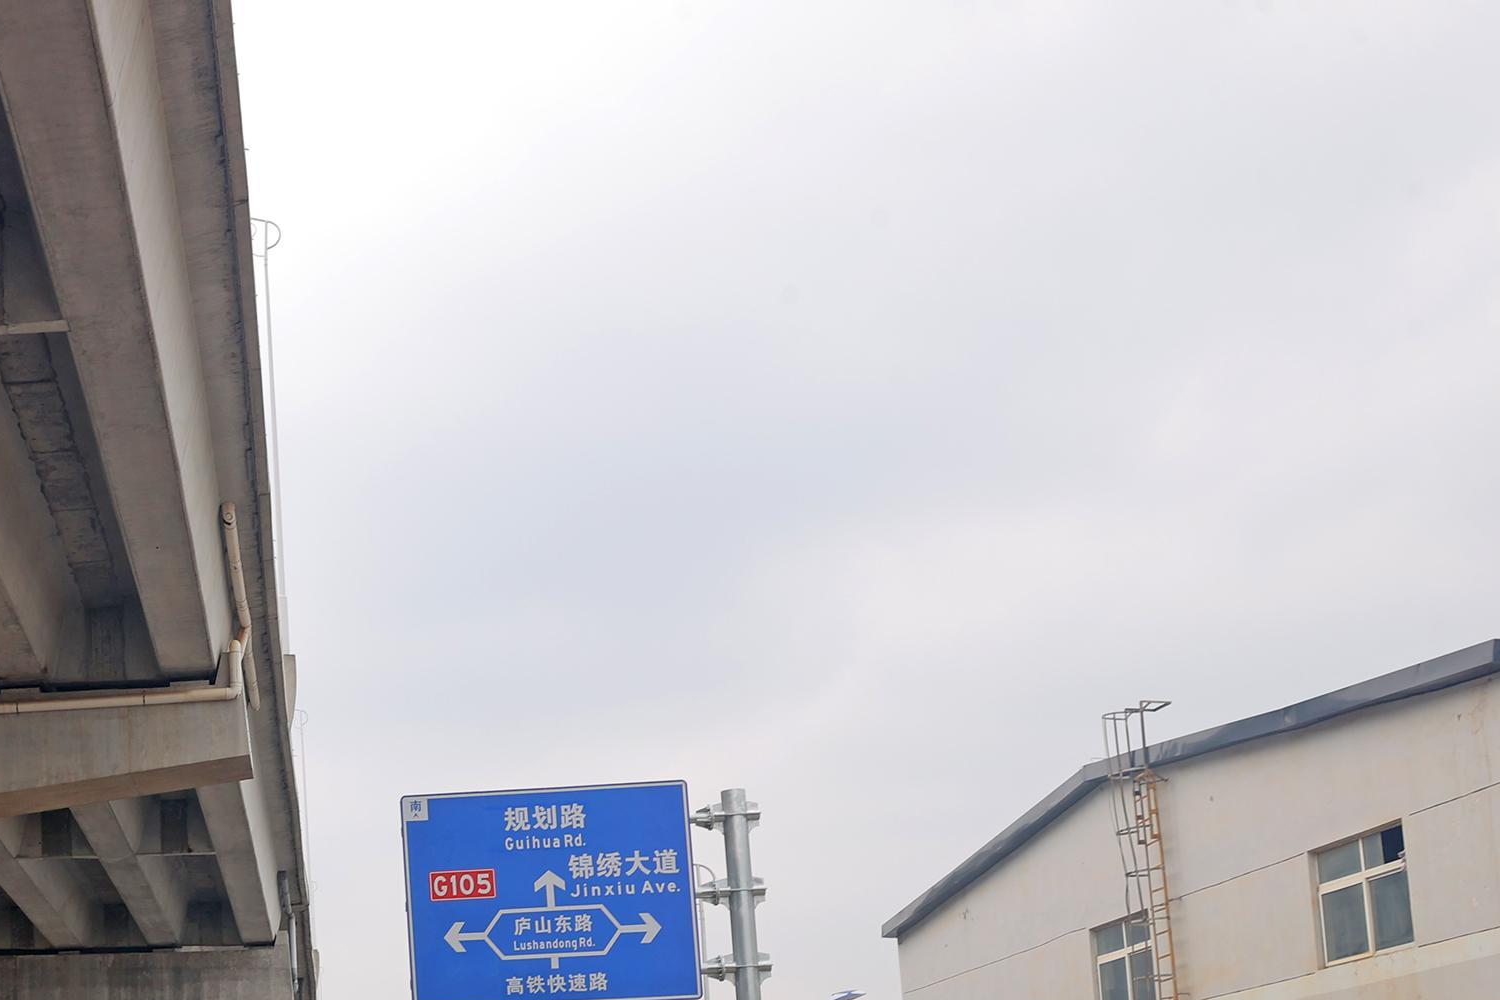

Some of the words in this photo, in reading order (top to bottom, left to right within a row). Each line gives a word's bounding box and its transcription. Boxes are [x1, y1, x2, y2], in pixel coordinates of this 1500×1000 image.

[410, 800, 421, 812] 南
[504, 803, 587, 832] 规划路
[505, 837, 561, 851] Guihua
[563, 834, 587, 848] Rd.
[568, 849, 680, 880] 锦绣大道
[433, 873, 493, 897] G105
[570, 882, 636, 898] Jinxiu
[641, 880, 681, 895] Ave.
[513, 914, 593, 936] 庐山东路
[513, 938, 578, 952] Lushandong
[579, 936, 596, 948] Rd.
[506, 972, 608, 996] 高铁快速路
